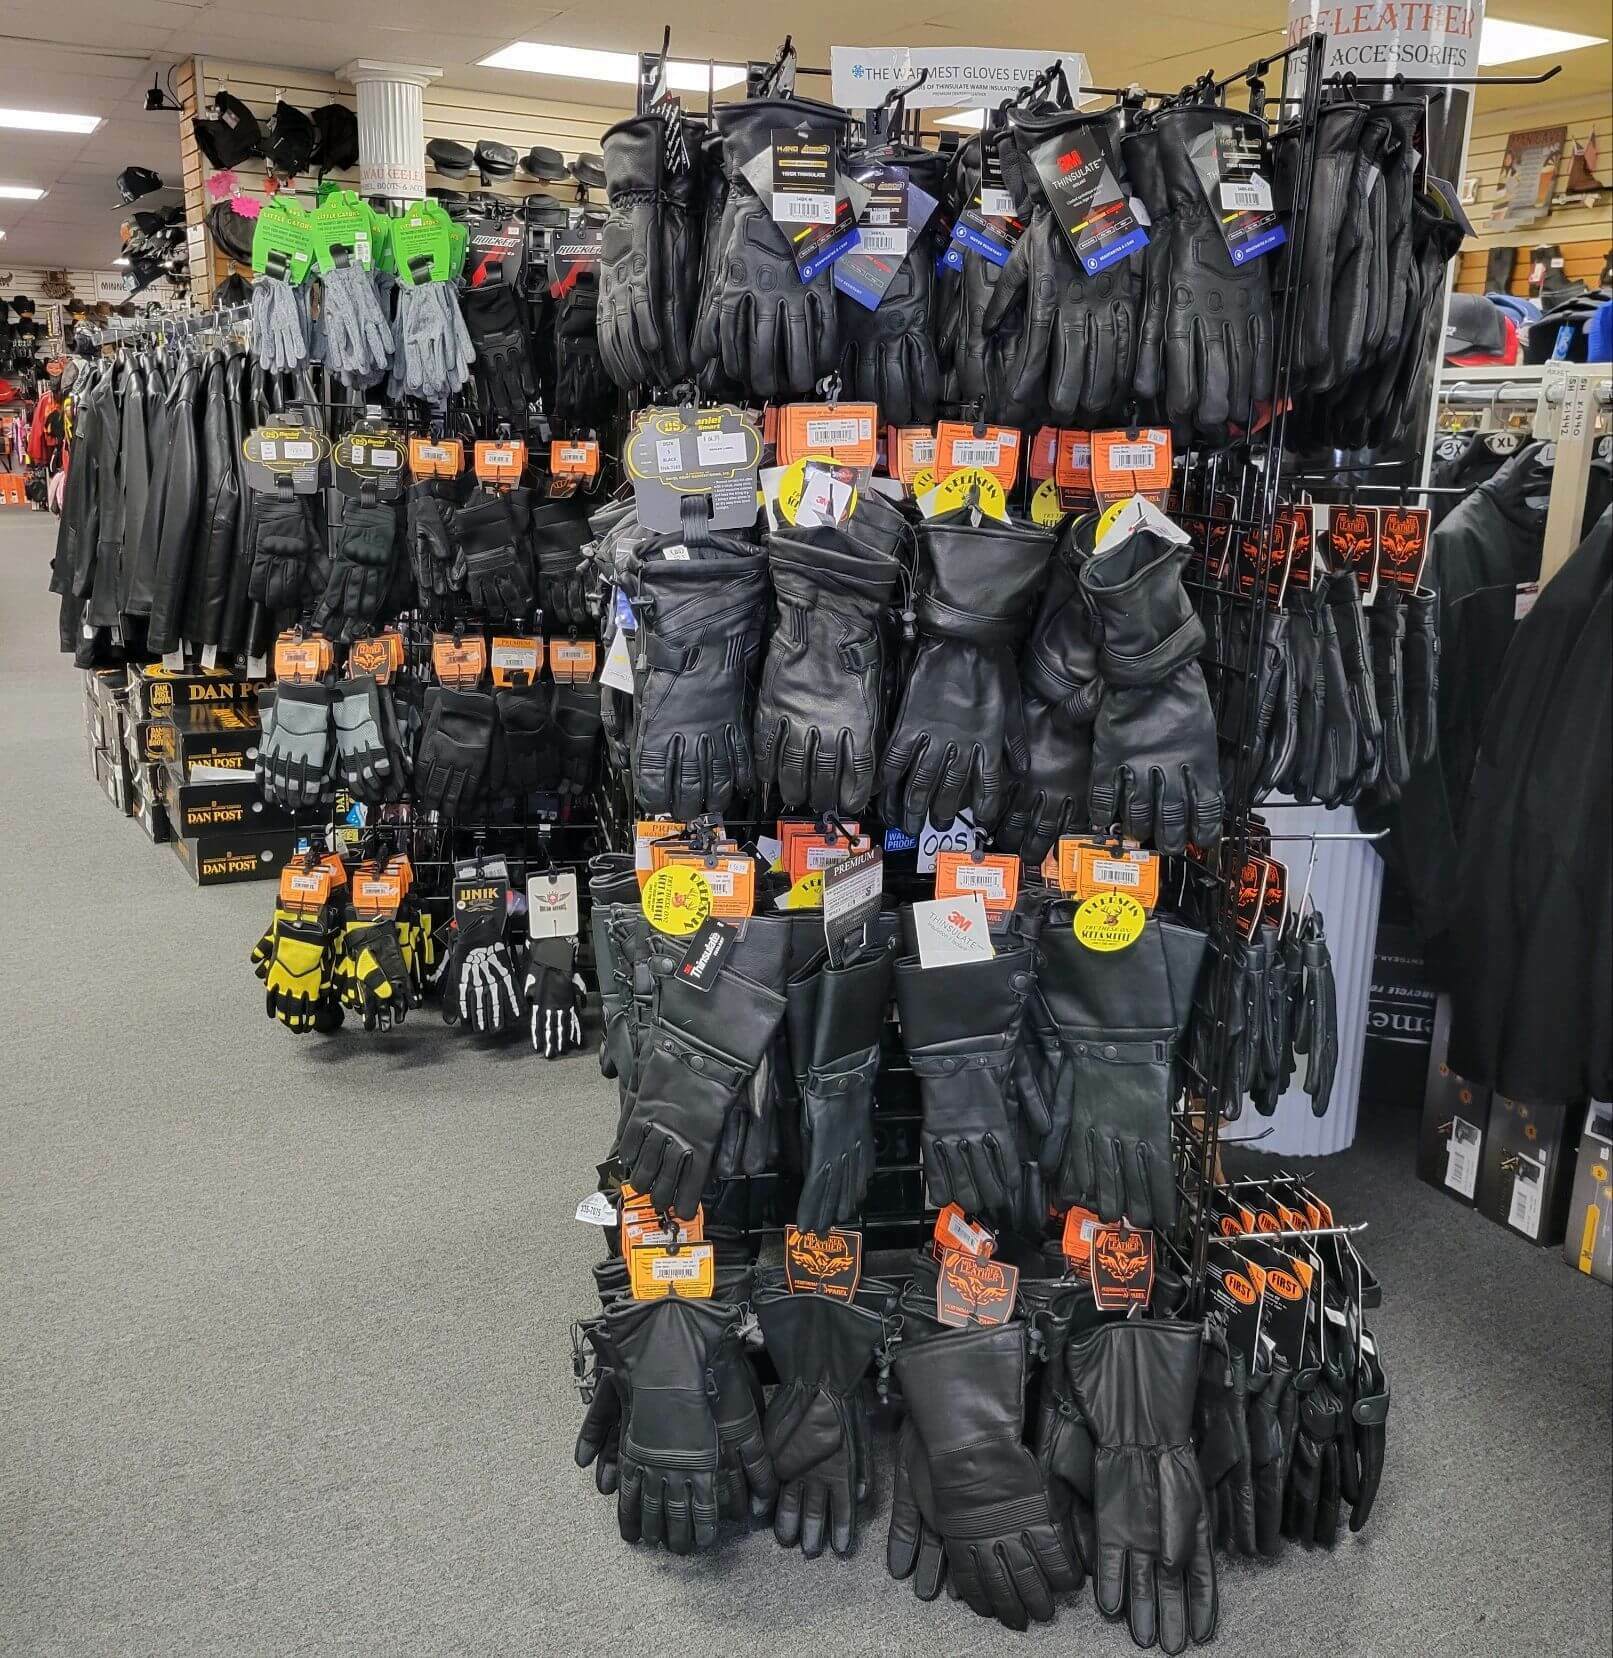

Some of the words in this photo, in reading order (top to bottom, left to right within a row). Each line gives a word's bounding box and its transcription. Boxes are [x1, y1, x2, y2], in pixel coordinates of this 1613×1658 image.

[1329, 45, 1467, 68] ACCESSORIES
[865, 67, 889, 80] THE
[963, 67, 1009, 80] GLOVES
[1052, 161, 1100, 190] THINSULATE
[695, 416, 722, 425] aniel
[1497, 437, 1514, 448] XL
[188, 683, 234, 700] DAN
[214, 757, 243, 769] POST
[187, 812, 211, 825] DAN
[214, 809, 243, 822] POST
[887, 838, 916, 850] PROOF
[203, 863, 226, 875] DAN
[228, 860, 257, 872] POST
[833, 849, 876, 877] PREMIUM
[461, 887, 500, 901] UNIK
[947, 910, 973, 932] 3M
[929, 911, 977, 949] THINSULATE
[690, 932, 721, 978] Thinsulate
[1107, 1241, 1140, 1251] LEATHER
[1228, 1275, 1251, 1299] FIRST
[1271, 1271, 1298, 1295] FIRST
